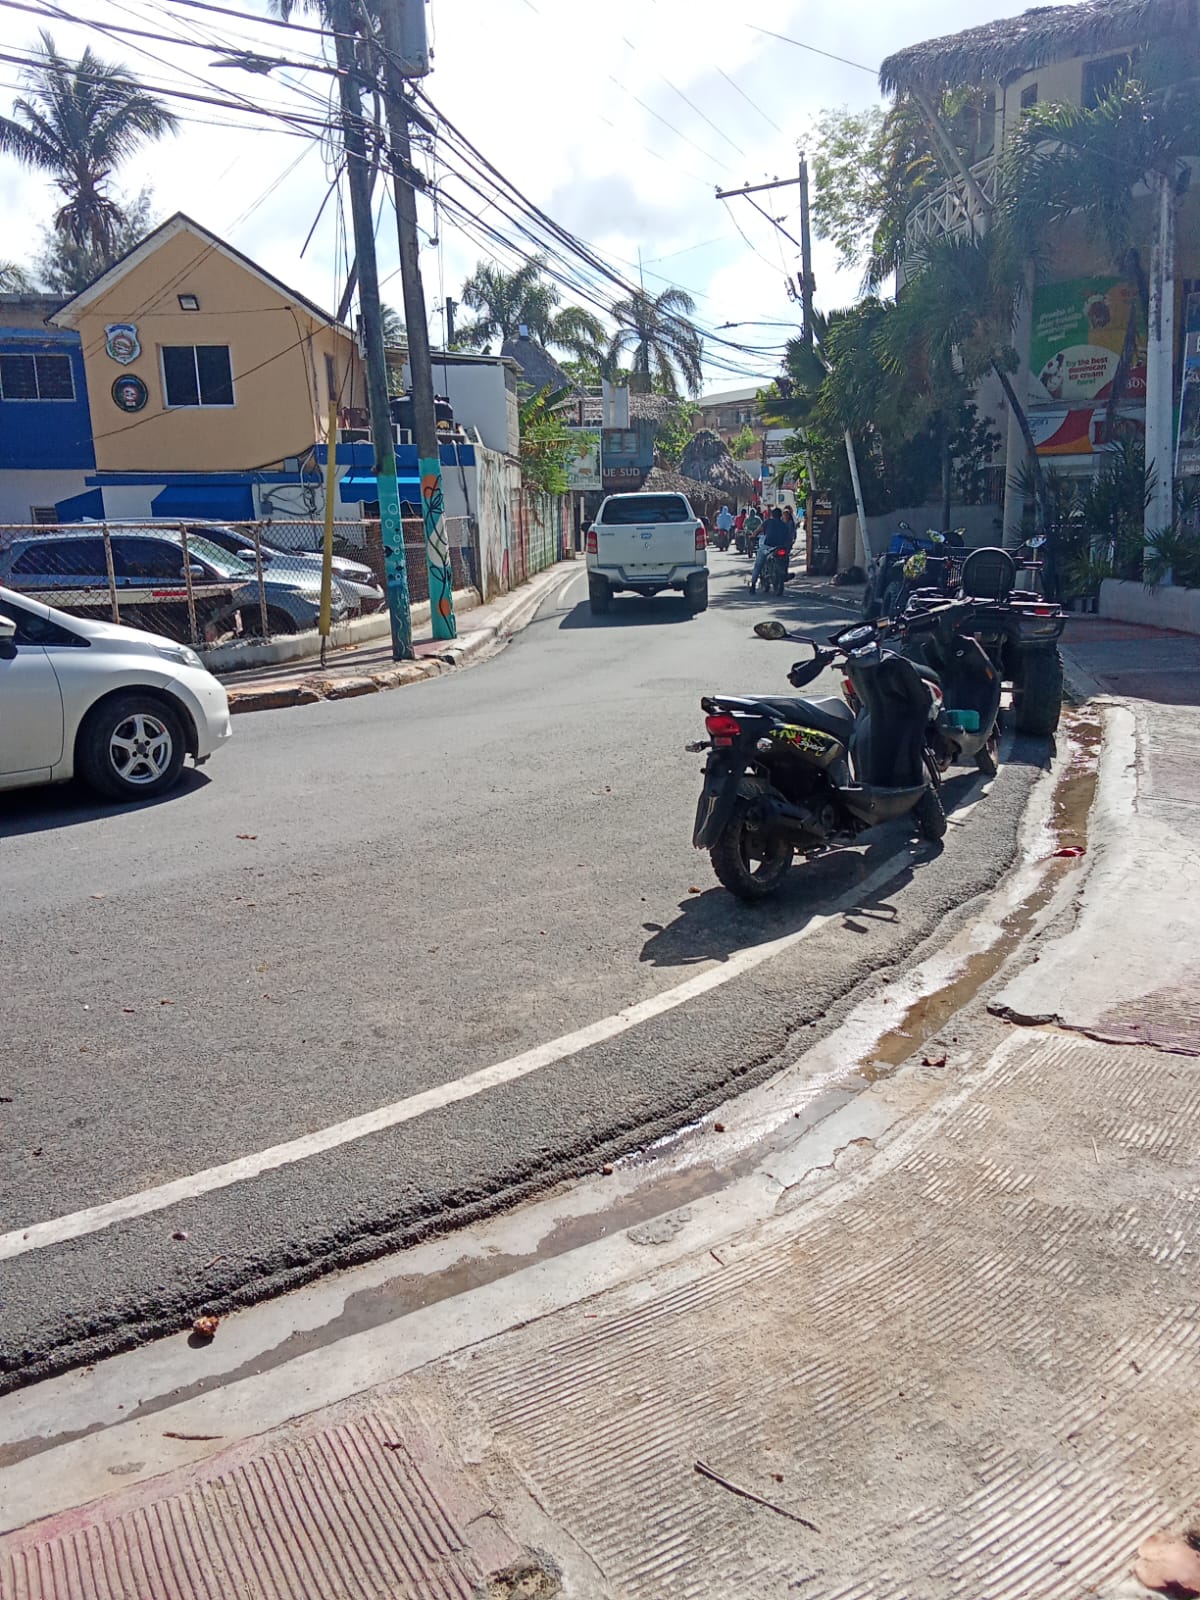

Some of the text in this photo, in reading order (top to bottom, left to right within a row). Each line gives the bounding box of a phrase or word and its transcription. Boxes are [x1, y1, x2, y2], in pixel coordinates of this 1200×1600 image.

[1091, 356, 1108, 365] best
[1068, 365, 1107, 374] dominican
[1080, 371, 1104, 379] cream
[619, 468, 640, 477] SUD
